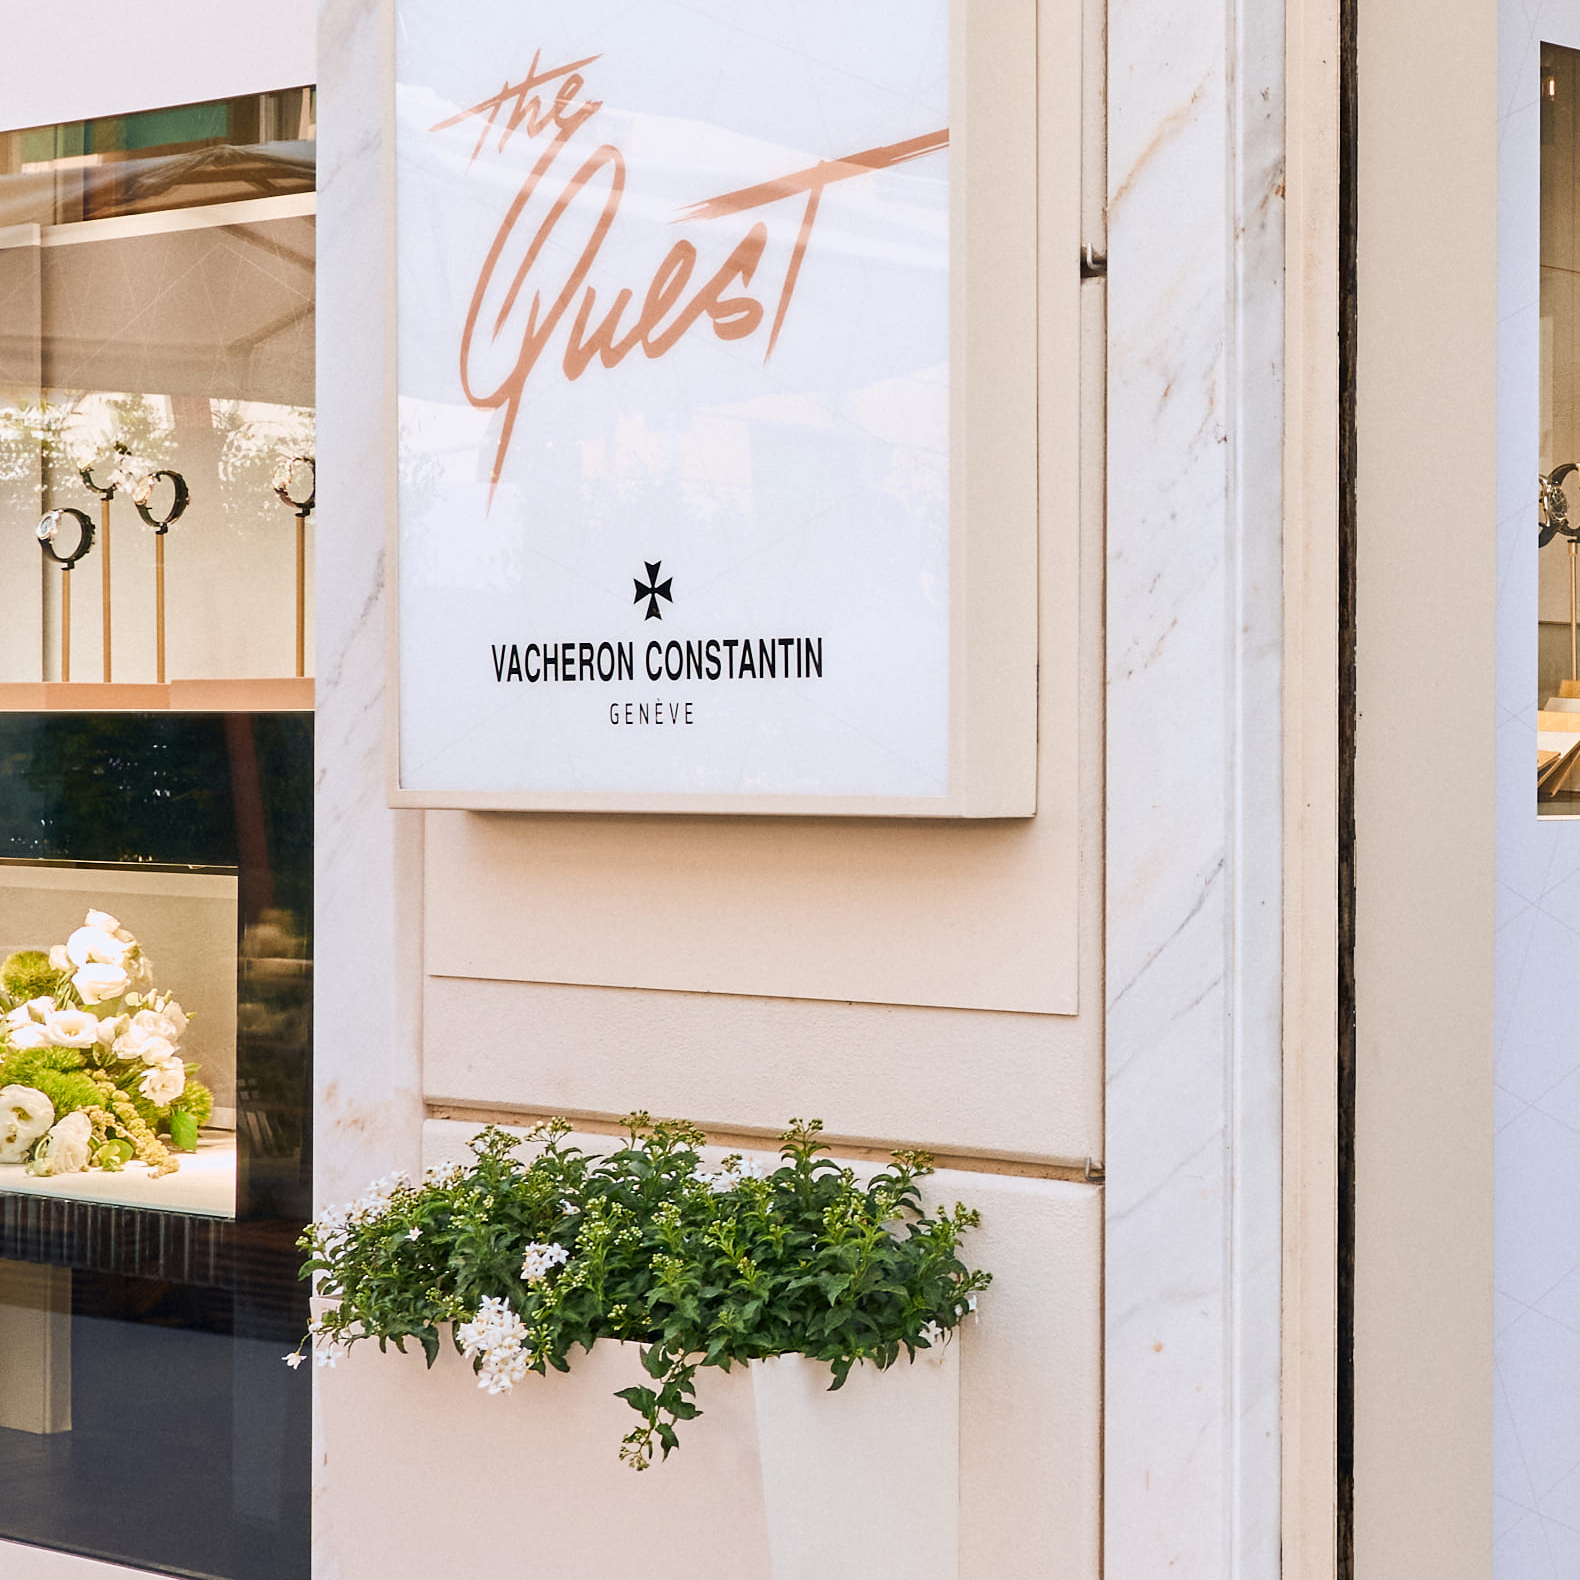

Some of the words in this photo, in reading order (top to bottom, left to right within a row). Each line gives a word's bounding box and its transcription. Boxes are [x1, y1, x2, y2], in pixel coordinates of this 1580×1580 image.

[428, 48, 604, 167] the
[491, 642, 635, 683] VACHERON
[645, 637, 824, 681] CONSTANTIN
[609, 699, 695, 725] GENÈVE
